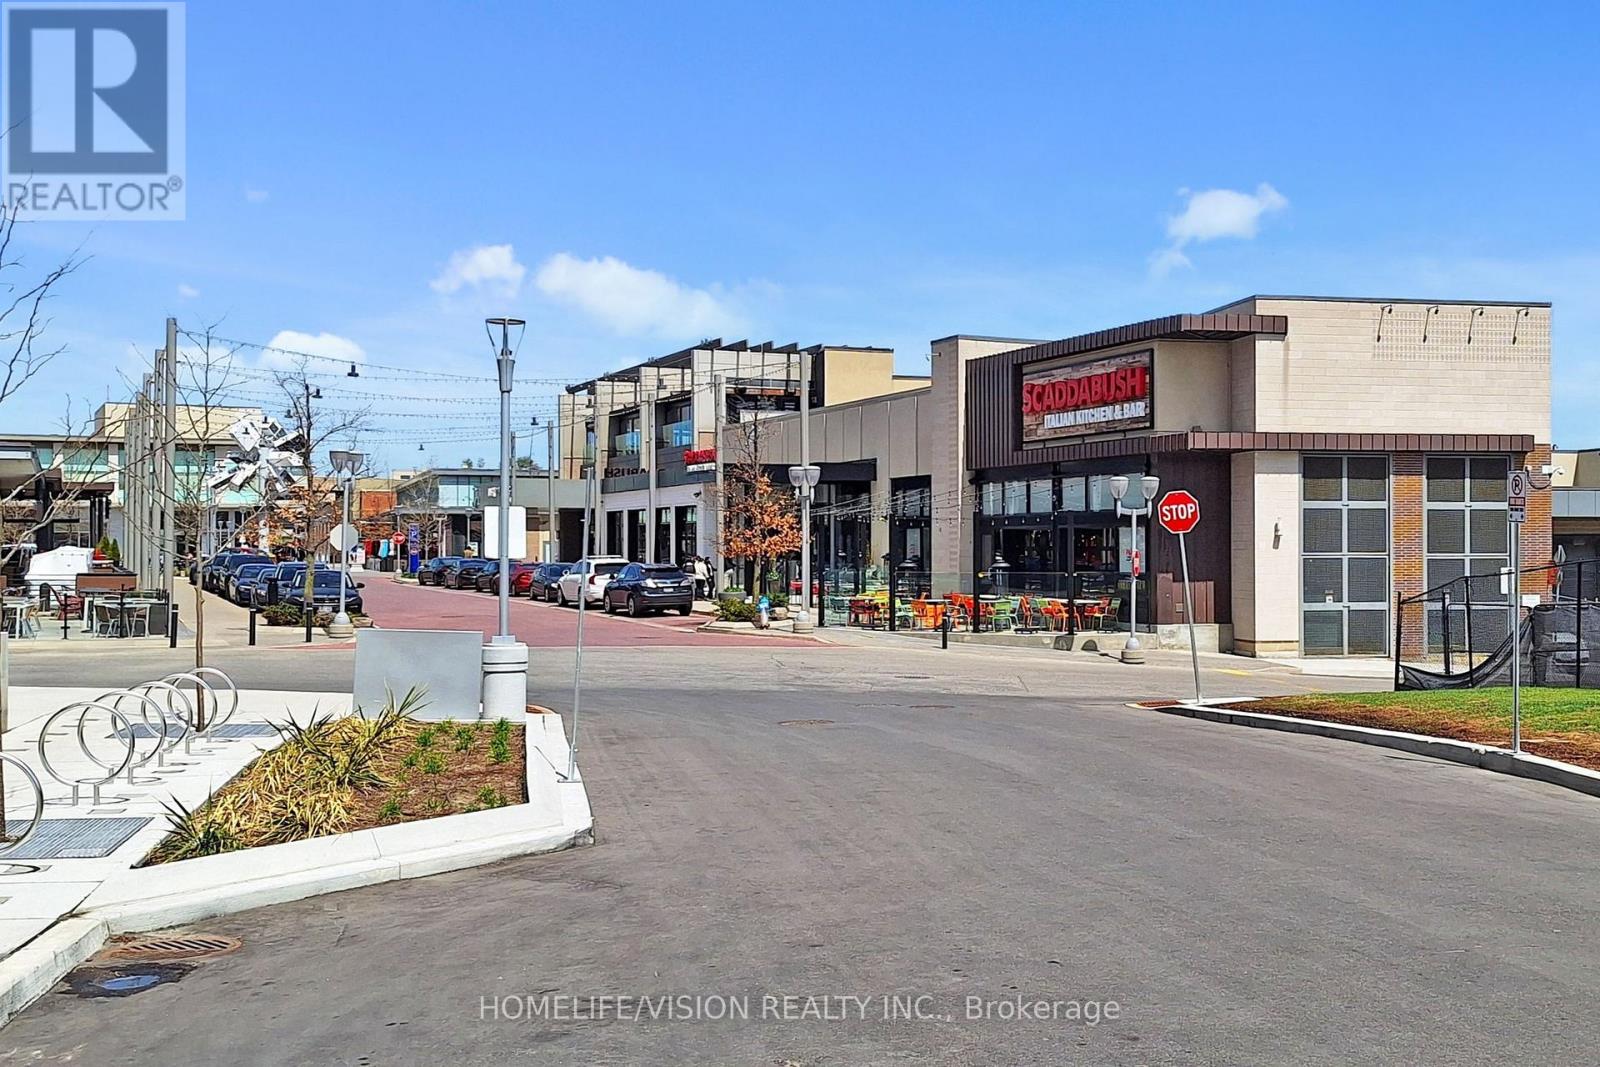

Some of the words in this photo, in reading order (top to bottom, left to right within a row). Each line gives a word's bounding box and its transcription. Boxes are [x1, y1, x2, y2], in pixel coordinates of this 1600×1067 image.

[1022, 366, 1147, 414] SCADDABUSH
[1075, 405, 1114, 425] KITCHEN
[1114, 404, 1123, 420] &
[1123, 401, 1146, 418] BAR
[1162, 503, 1196, 521] STOP
